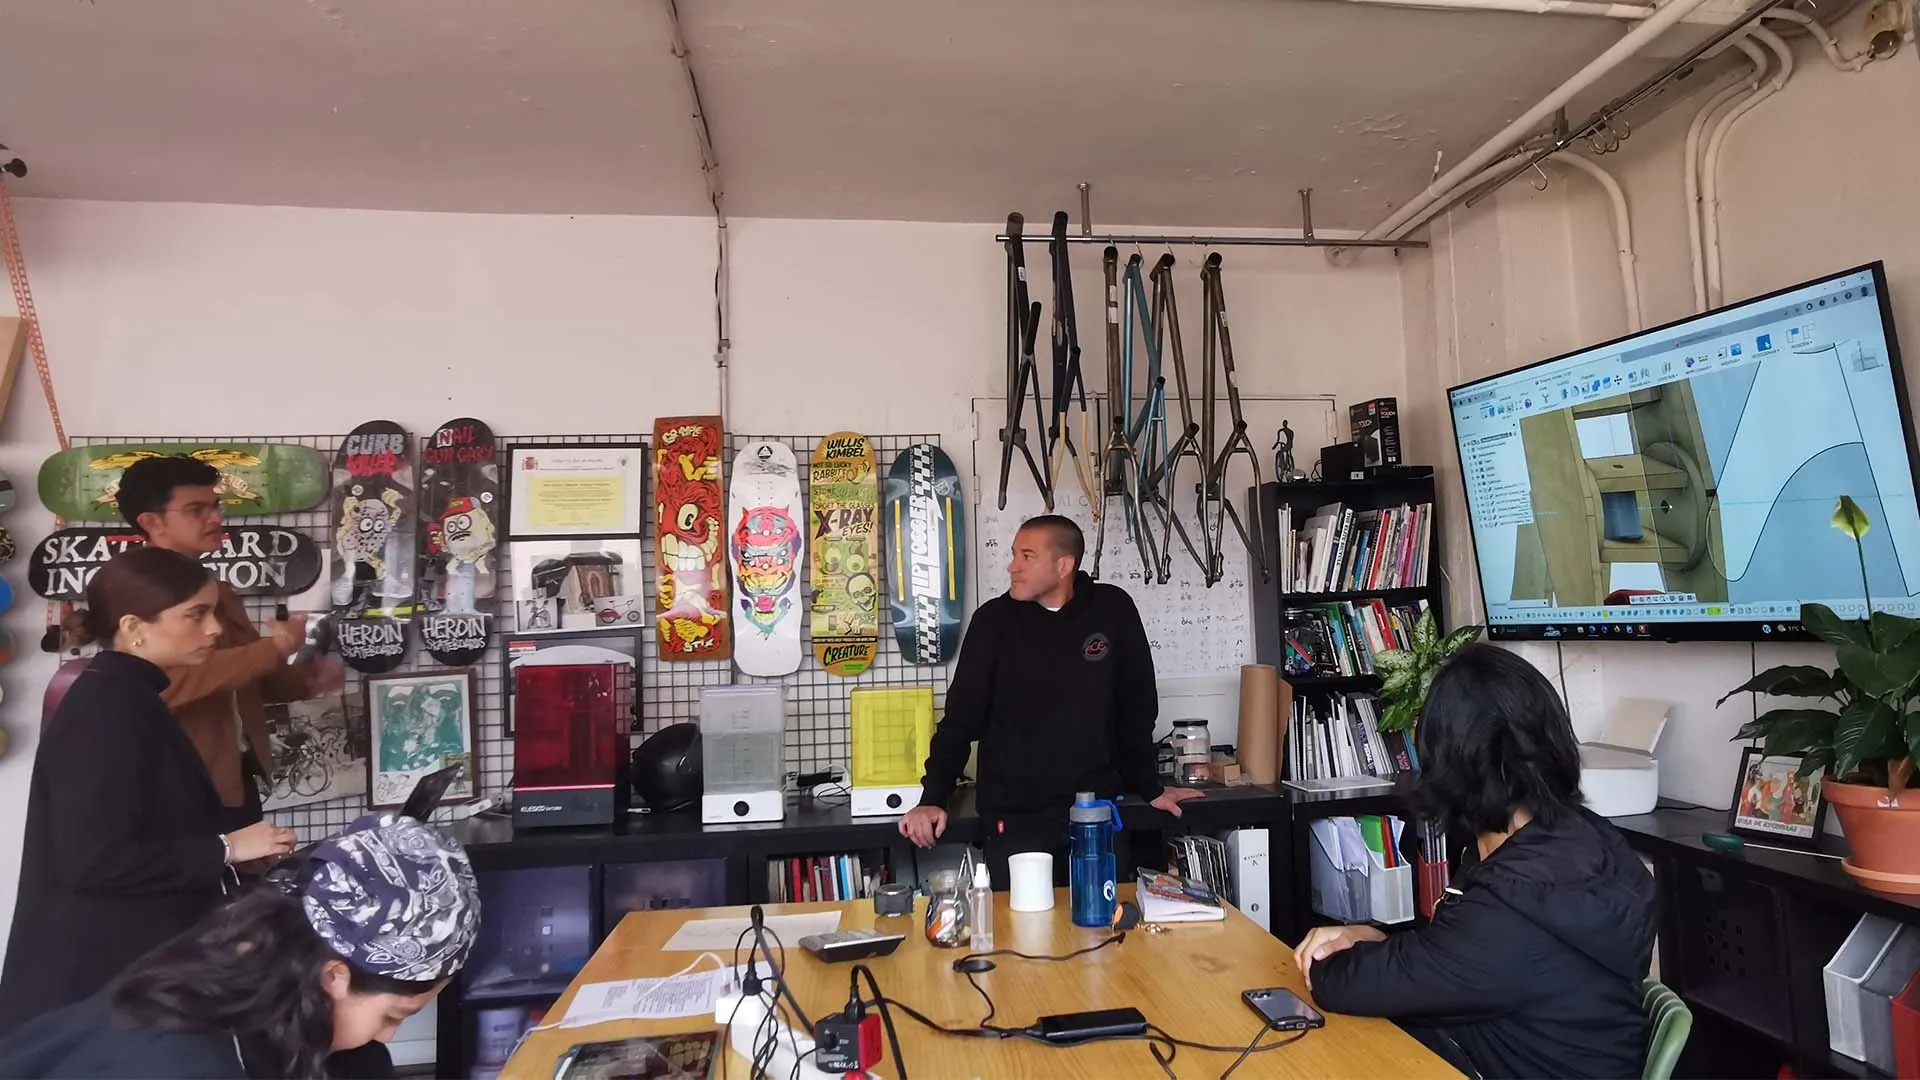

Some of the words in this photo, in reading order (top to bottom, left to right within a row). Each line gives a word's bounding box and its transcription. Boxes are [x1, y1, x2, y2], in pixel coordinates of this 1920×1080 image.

[347, 433, 405, 456] CURB
[825, 447, 866, 459] KIMBEL
[827, 437, 865, 450] WILLIS
[813, 508, 874, 540] X-RAY
[842, 522, 873, 537] EYES!
[338, 622, 404, 646] HEROIN
[422, 615, 487, 639] HEROIN
[341, 643, 404, 659] SKATEBOARDS
[426, 636, 486, 652] SKATEBOARDS
[823, 644, 870, 666] CREATURE
